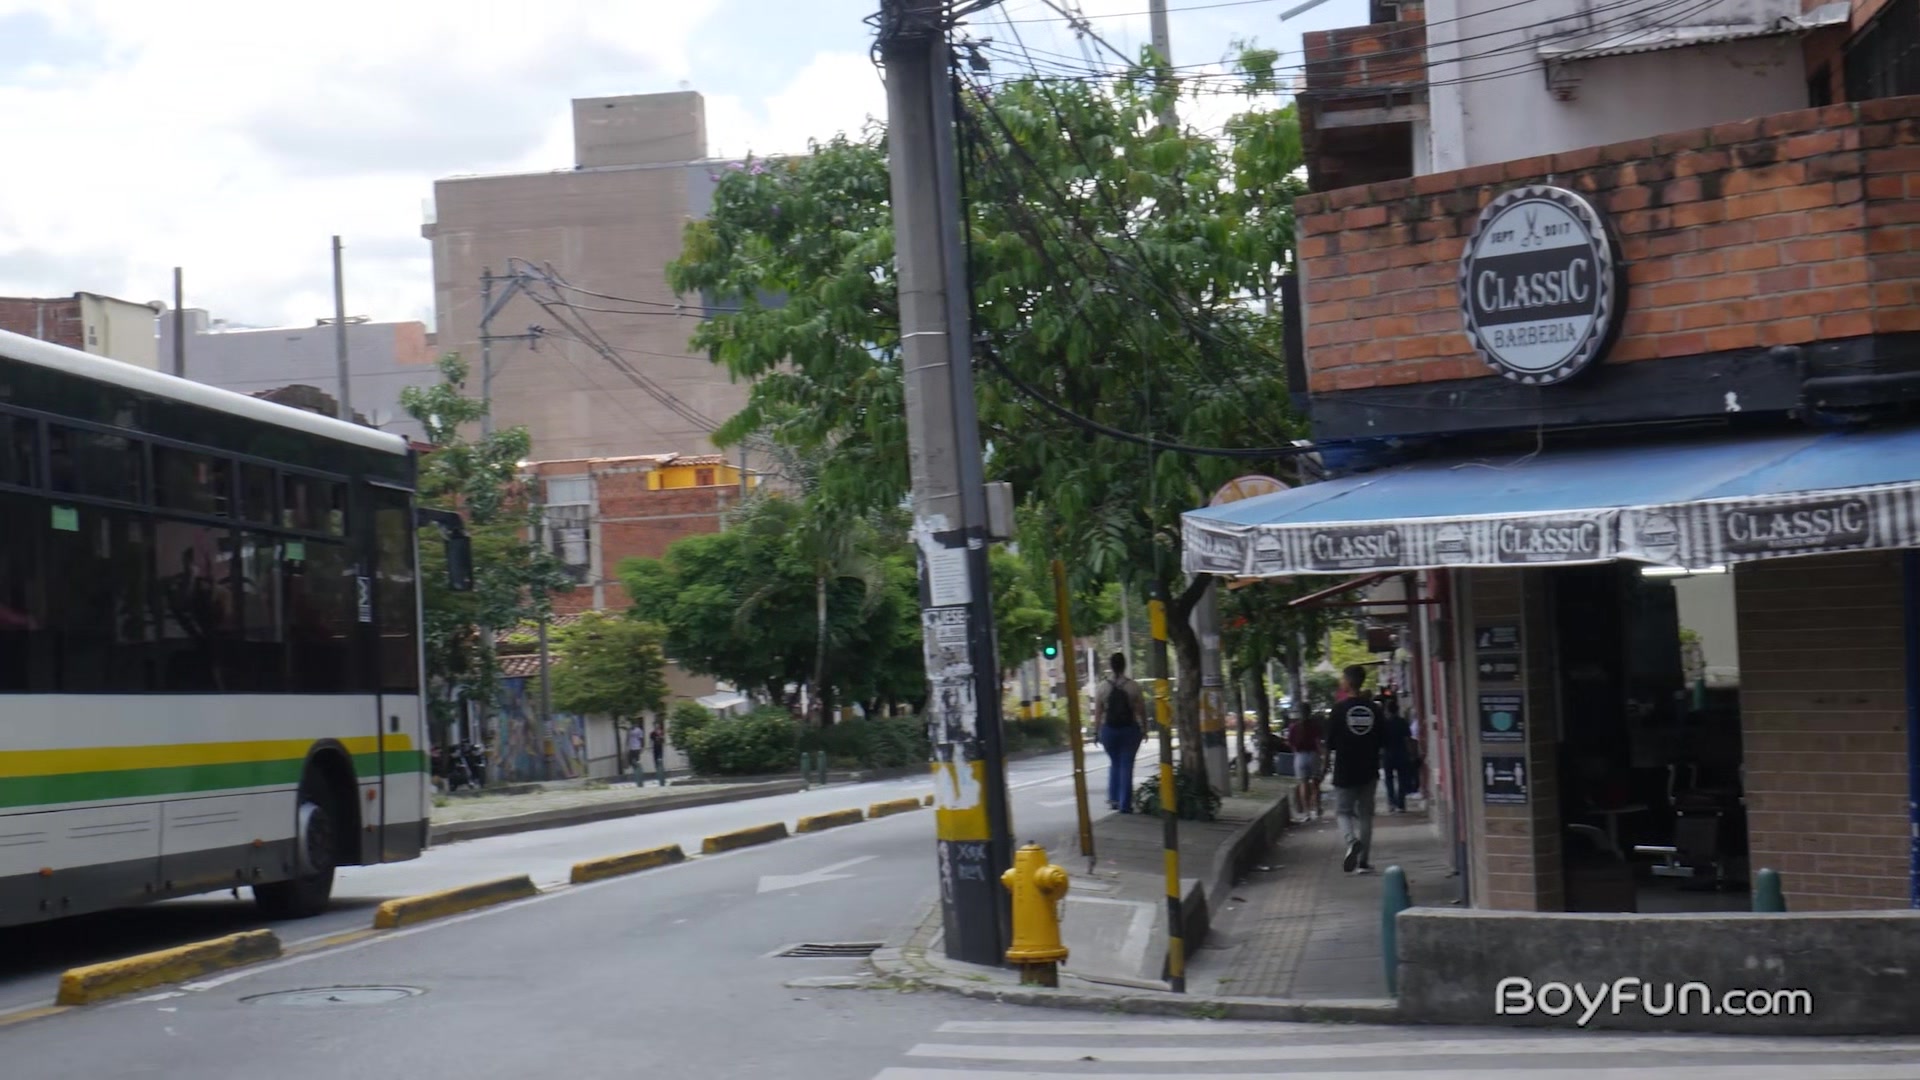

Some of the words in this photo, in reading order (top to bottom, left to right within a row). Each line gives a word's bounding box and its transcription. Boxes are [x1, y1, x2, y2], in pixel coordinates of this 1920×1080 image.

[1544, 222, 1571, 237] 2017
[1477, 257, 1589, 314] CLASSIC
[1493, 321, 1577, 349] BARBERIA
[1499, 522, 1595, 554] CLASSIC
[1726, 502, 1863, 542] CLASSIC
[1313, 529, 1399, 561] CLASSIC
